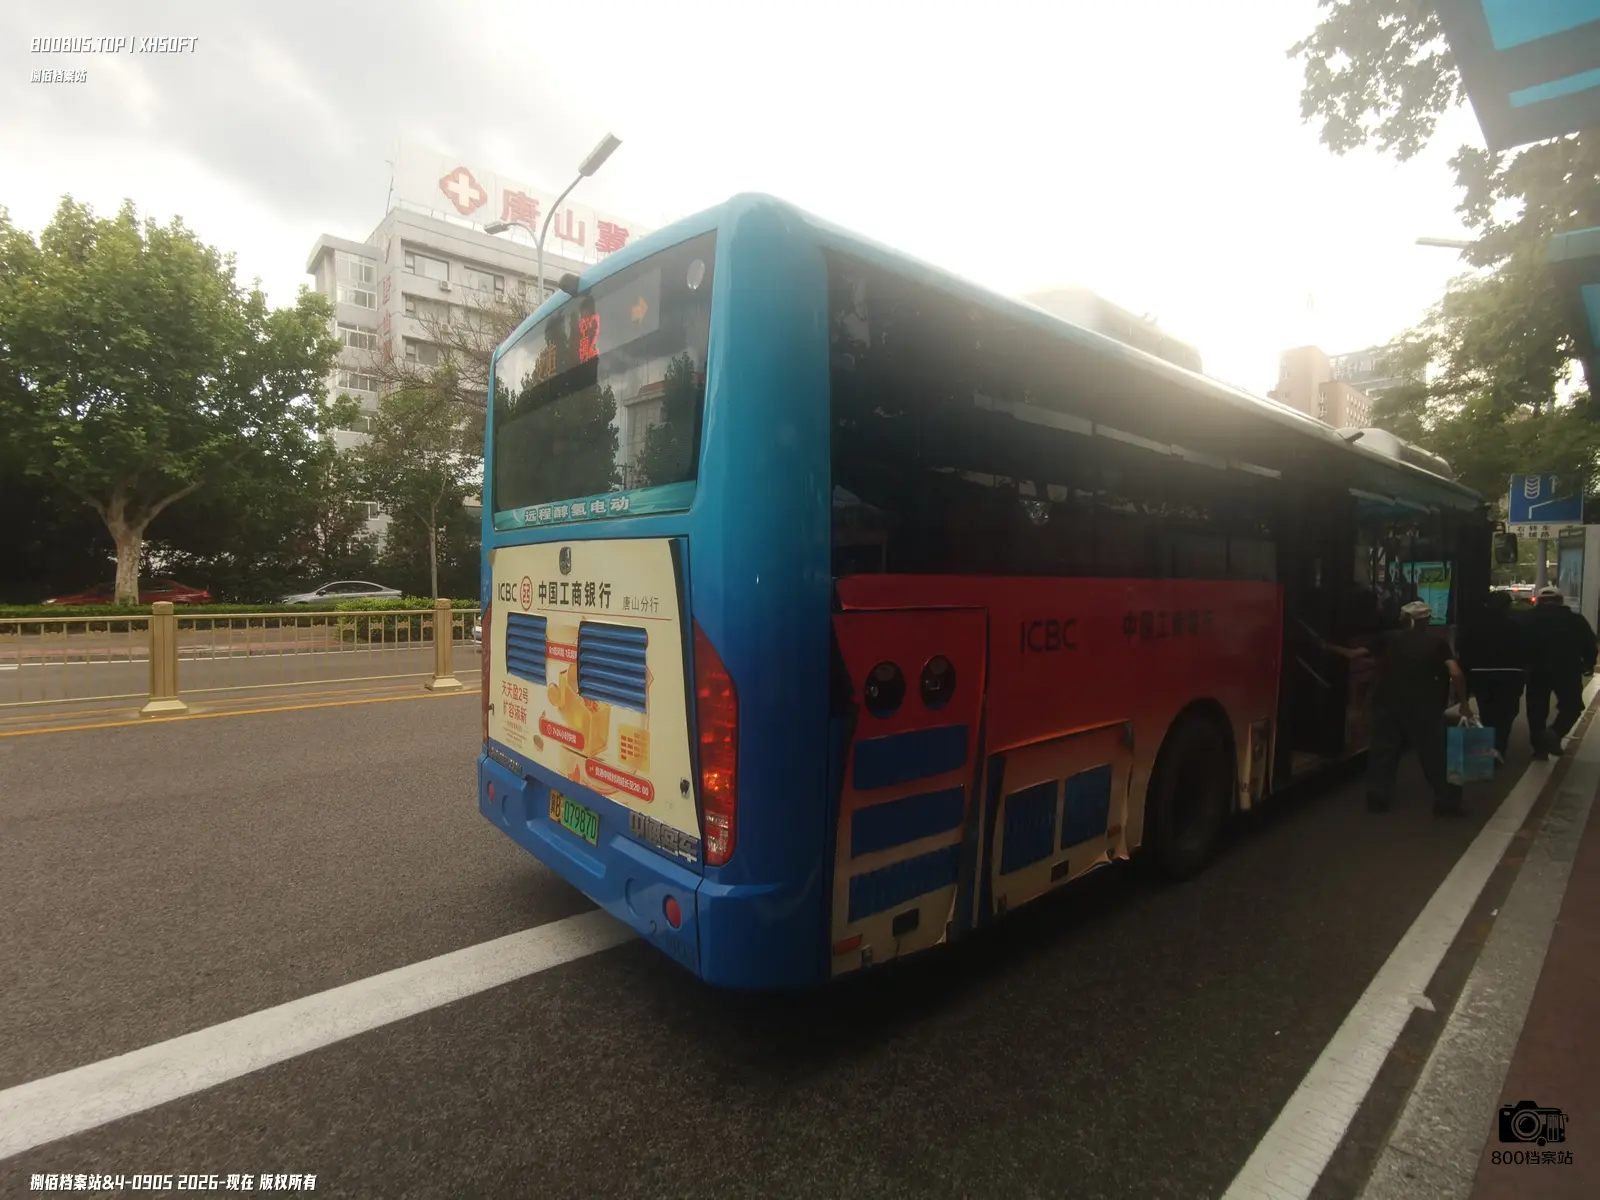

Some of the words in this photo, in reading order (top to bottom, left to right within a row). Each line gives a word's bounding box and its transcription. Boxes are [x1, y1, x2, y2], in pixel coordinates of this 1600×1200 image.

[525, 496, 629, 522] 远程醇氢电动
[498, 583, 517, 602] ICBC
[538, 581, 612, 609] 中国工商银行
[622, 596, 659, 613] 唐山分行
[1020, 618, 1078, 655] ICBC
[502, 681, 529, 704] 天天盈2号
